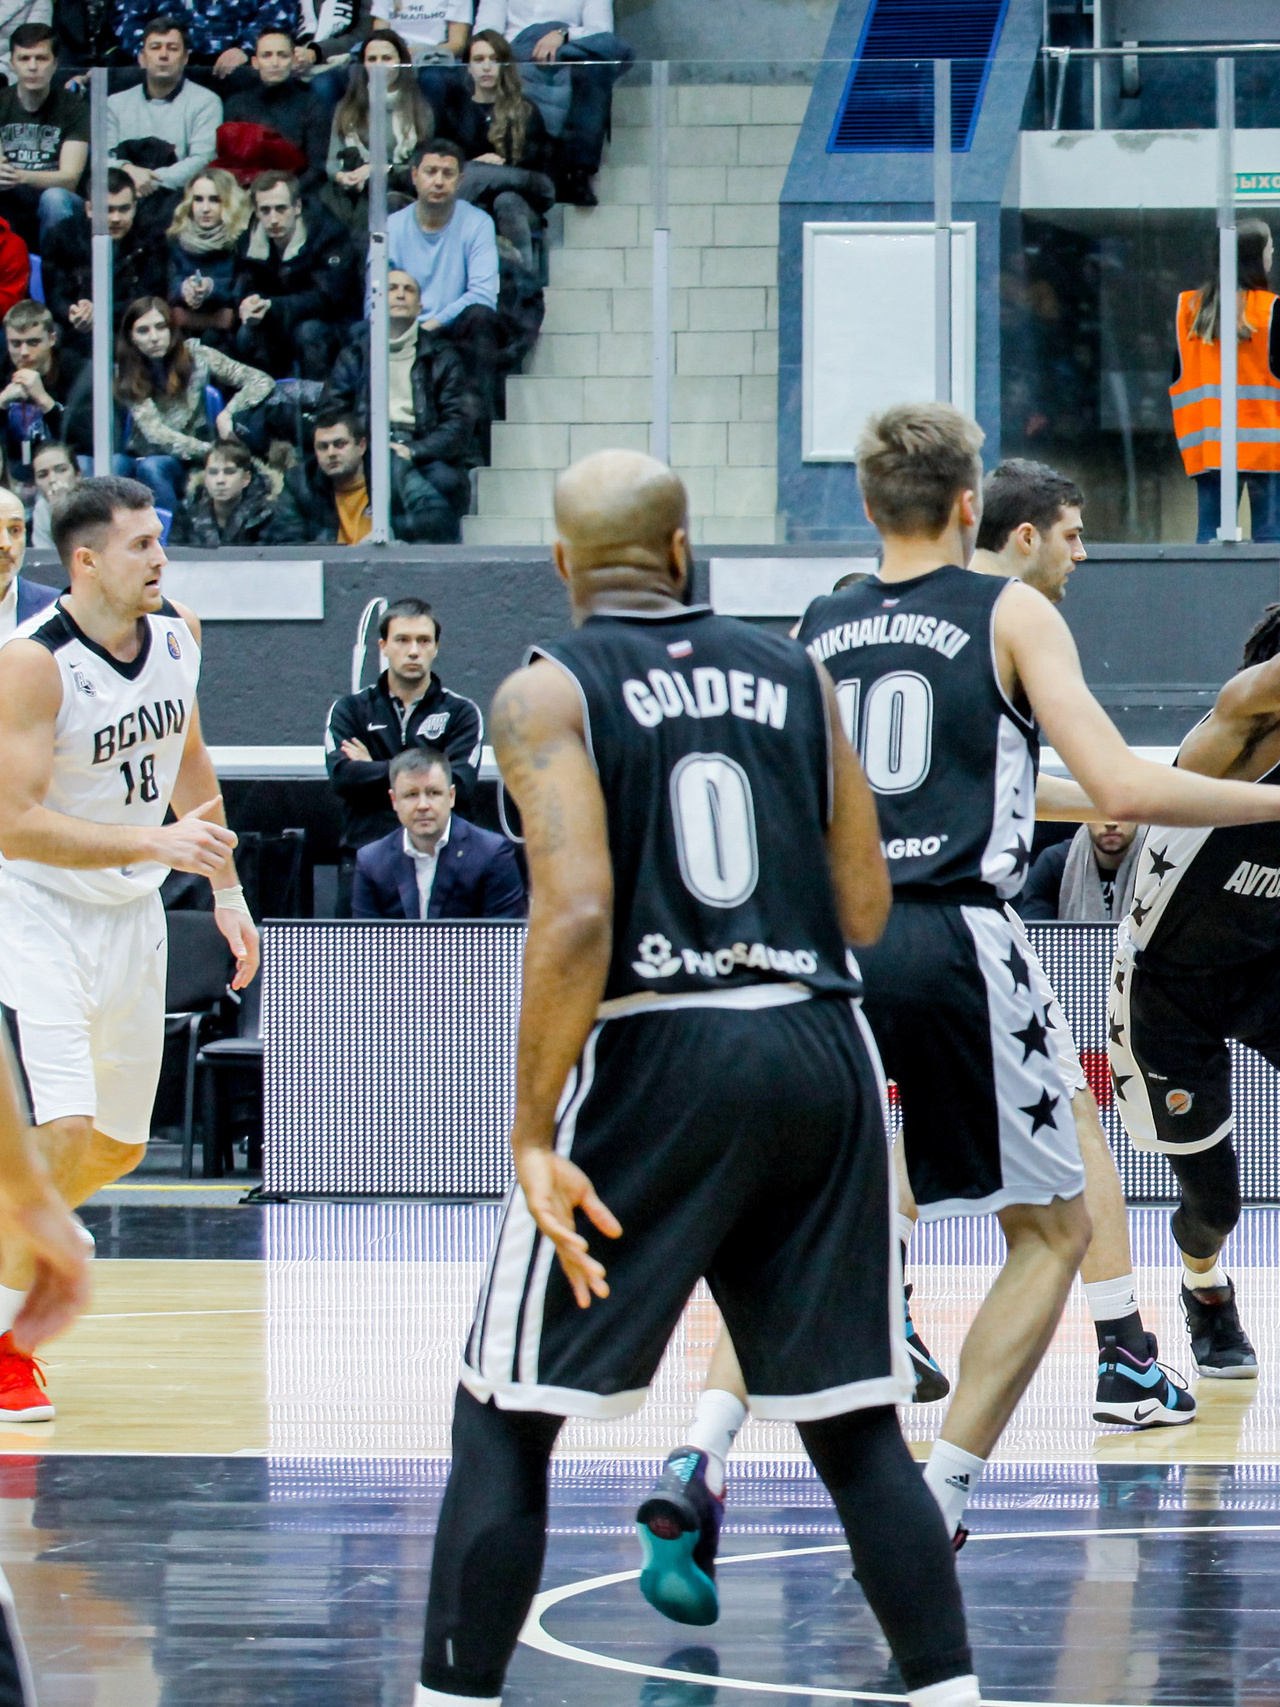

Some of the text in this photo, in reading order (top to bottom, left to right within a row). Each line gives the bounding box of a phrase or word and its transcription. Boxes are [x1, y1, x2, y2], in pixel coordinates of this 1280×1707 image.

[622, 667, 788, 731] GOLDEN
[92, 699, 186, 766] BCNN
[119, 753, 160, 806] 18
[669, 752, 759, 909] 0
